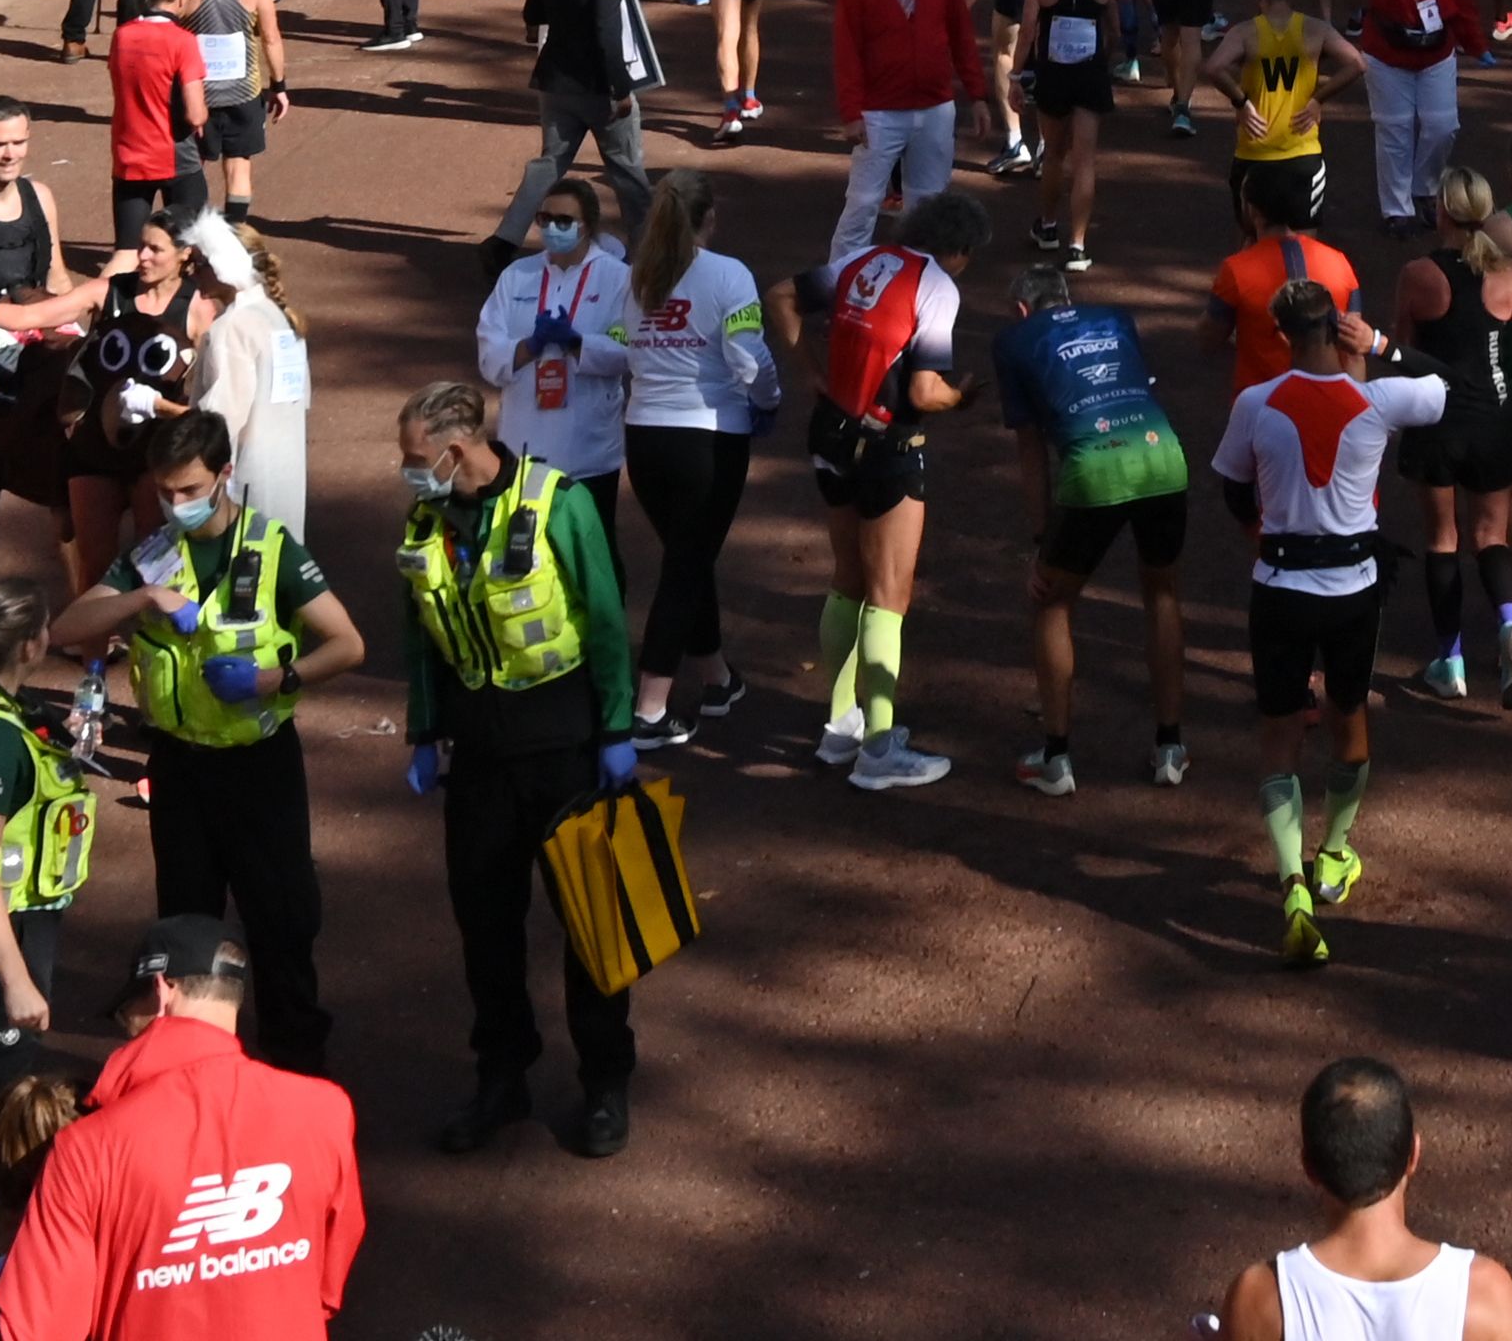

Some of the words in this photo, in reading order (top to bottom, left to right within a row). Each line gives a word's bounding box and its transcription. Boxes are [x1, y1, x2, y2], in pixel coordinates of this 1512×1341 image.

[1261, 56, 1298, 94] W
[161, 1163, 292, 1255] NB
[136, 1260, 194, 1292] new
[201, 1237, 310, 1281] balance
